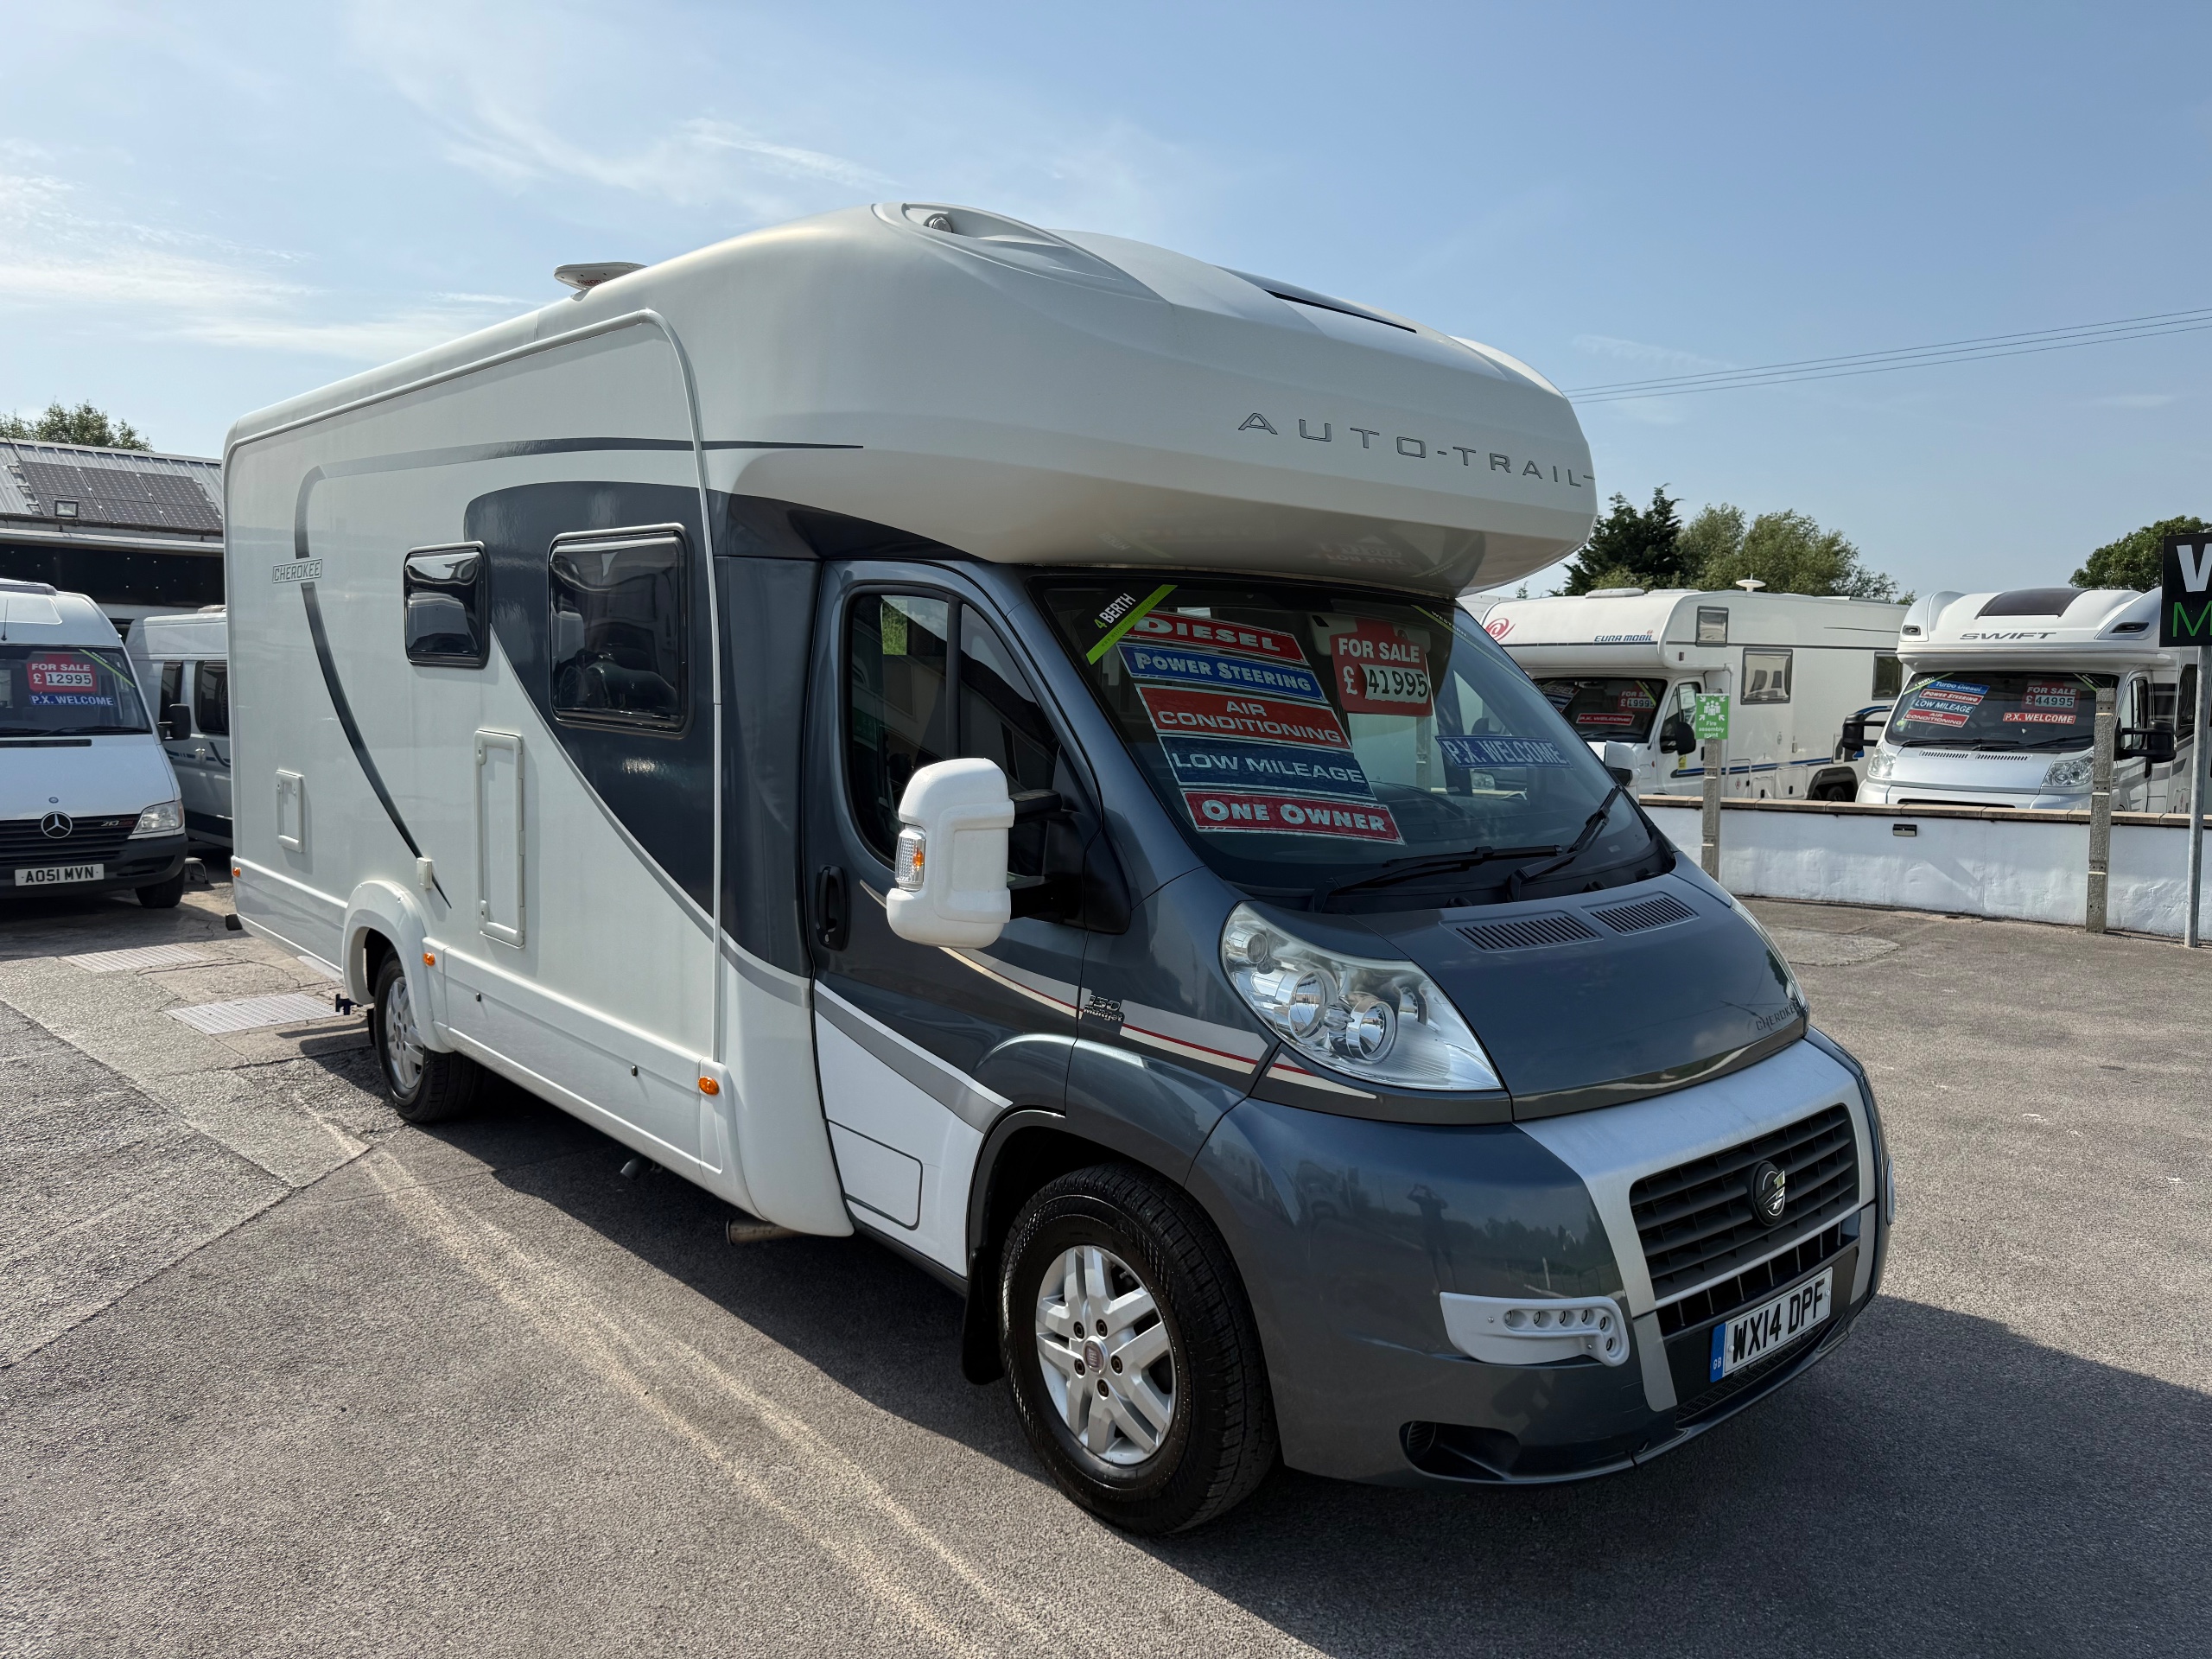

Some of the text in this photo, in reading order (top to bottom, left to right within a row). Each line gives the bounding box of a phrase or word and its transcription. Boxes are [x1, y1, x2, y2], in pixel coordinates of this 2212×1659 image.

[274, 562, 321, 582] CHEROKEE
[1094, 593, 1136, 629] 4 BERTH
[1133, 616, 1281, 652] DIESEL
[1959, 632, 2057, 640] SWIFT
[1338, 638, 1421, 664] FOR SALE
[33, 673, 92, 684] £ 12995
[1134, 652, 1312, 691] POWER STEERING
[1343, 665, 1429, 698] £ 41995
[30, 696, 114, 706] P.X. WELCOME
[1947, 694, 1979, 702] STEERING
[2025, 695, 2074, 707] £ 44995
[1226, 700, 1268, 717] AIR
[1936, 702, 1974, 713] MILEAGE
[1157, 711, 1342, 743] CONDITIONING
[1905, 715, 1962, 725] CONDITIONING
[2025, 714, 2074, 723] WELCOME
[1443, 741, 1567, 765] P.X. WELCOME
[1172, 752, 1366, 784] LOW MILEAGE
[1201, 800, 1387, 832] ONE OWNER
[25, 866, 94, 883] AO51 MVN
[1089, 995, 1121, 1011] 150
[1733, 1303, 1782, 1363] WX14
[1788, 1277, 1825, 1335] DPF
[1713, 1357, 1722, 1370] GB
